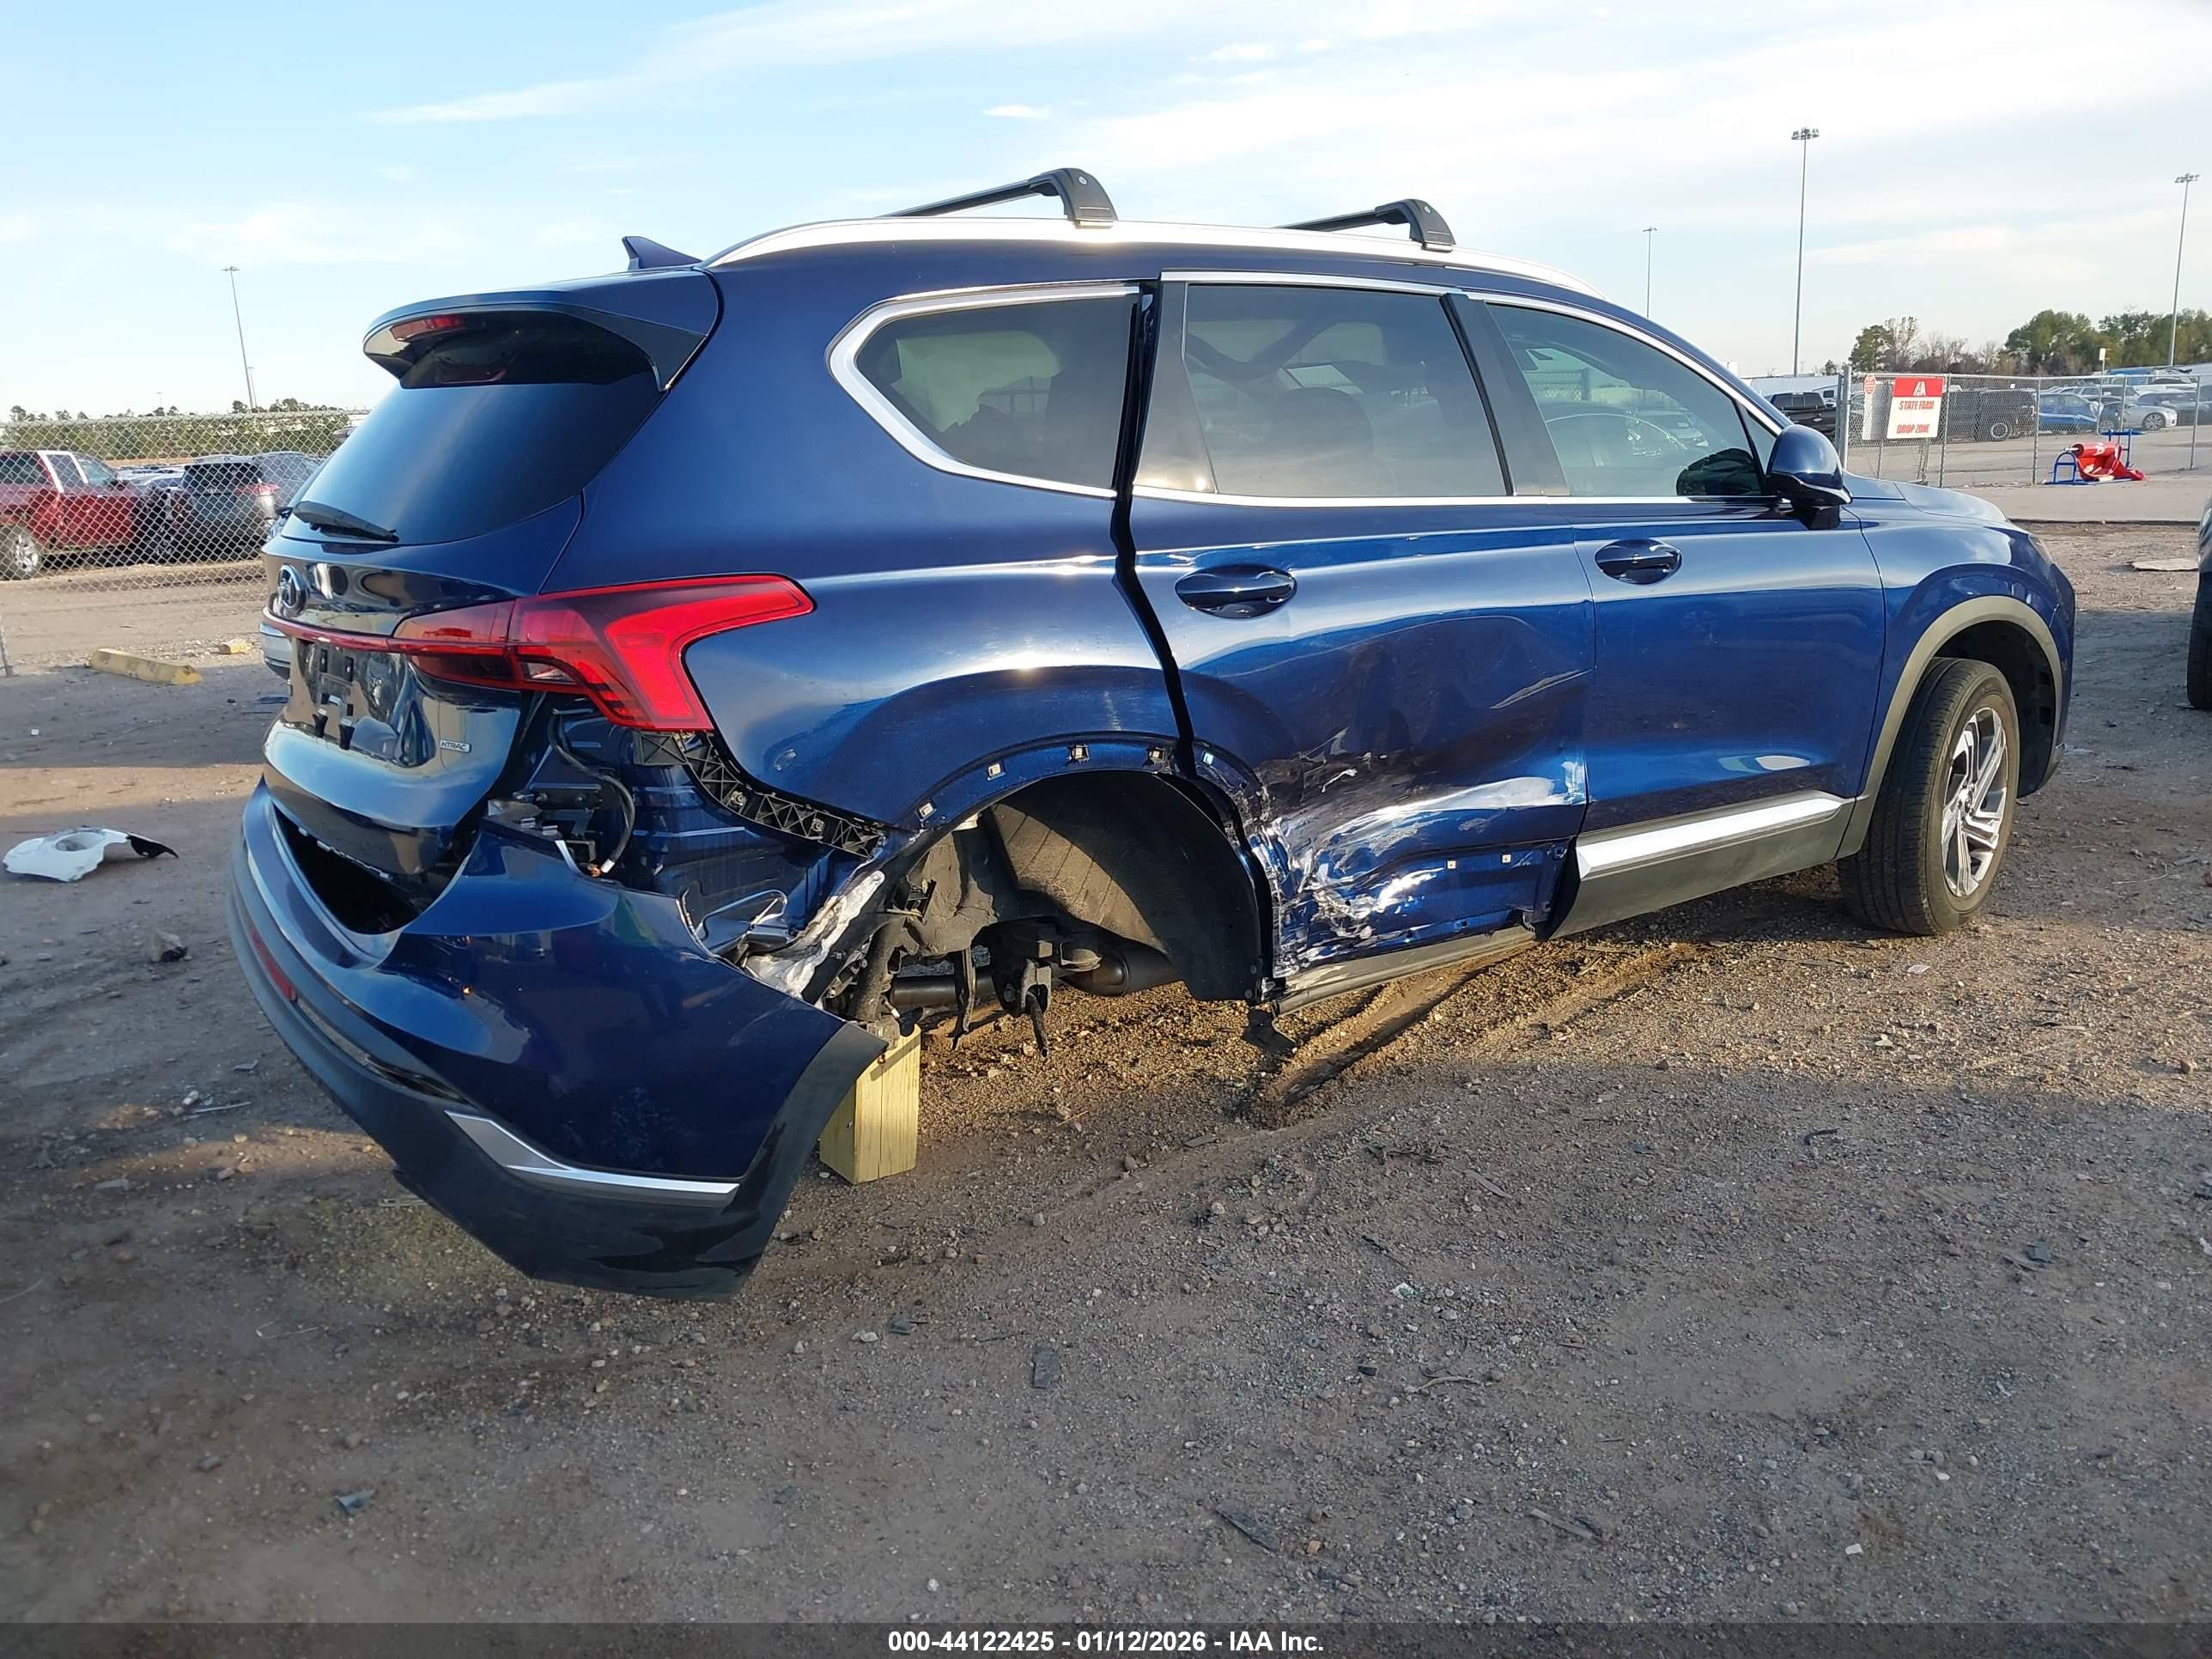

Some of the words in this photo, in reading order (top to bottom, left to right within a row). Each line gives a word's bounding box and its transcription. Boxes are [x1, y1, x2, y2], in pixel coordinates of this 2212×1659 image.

[1899, 400, 1918, 410] STATE
[1918, 400, 1935, 410] FARM
[1896, 424, 1915, 434] DROP
[1915, 424, 1929, 433] ZONE
[441, 741, 466, 750] HTRAC
